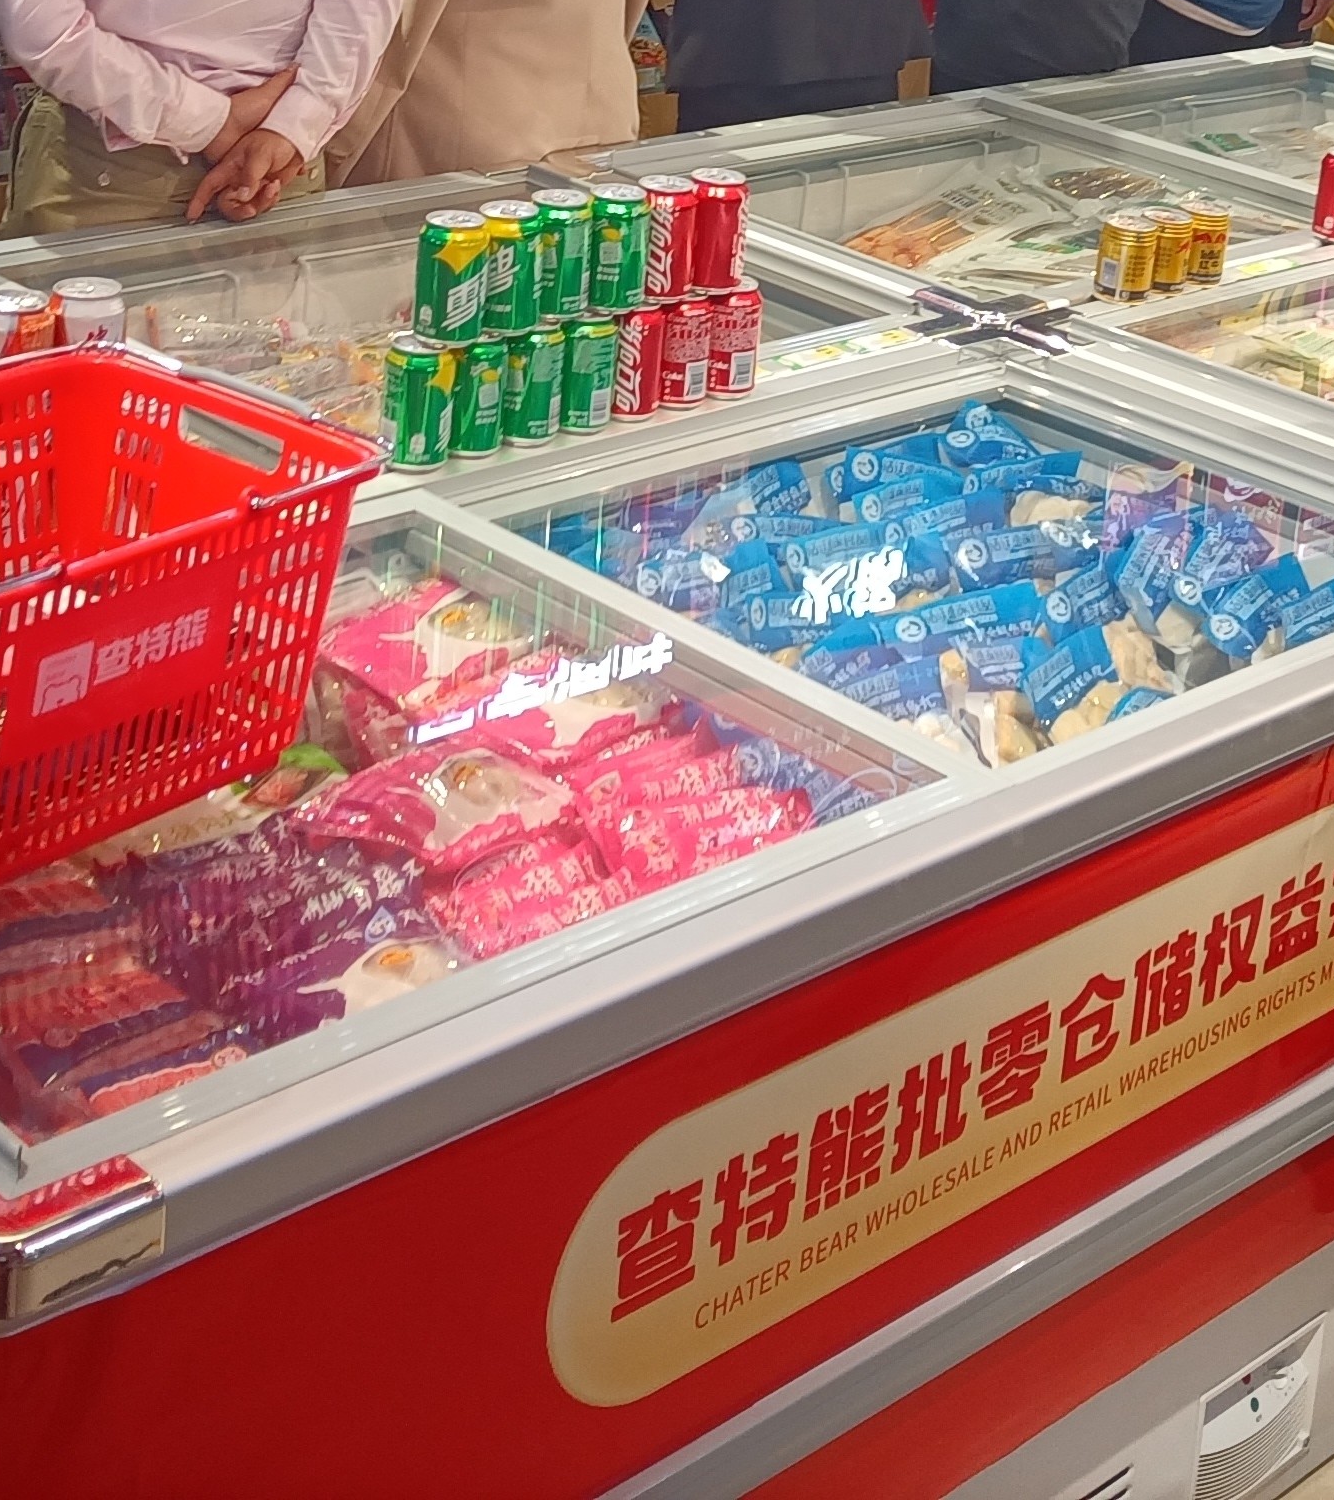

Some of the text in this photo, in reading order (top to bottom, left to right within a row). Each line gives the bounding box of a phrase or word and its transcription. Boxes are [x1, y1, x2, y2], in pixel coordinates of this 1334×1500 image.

[93, 606, 211, 686] 查特熊
[695, 1259, 790, 1329] CHATER
[800, 1222, 858, 1273] BEAR
[866, 1146, 995, 1236] WHOLESALE
[1000, 1121, 1042, 1163] AND
[1049, 1084, 1112, 1136] RETAIL
[1120, 1006, 1251, 1096] WAREHOUSING
[1256, 971, 1315, 1020] RIGHTS
